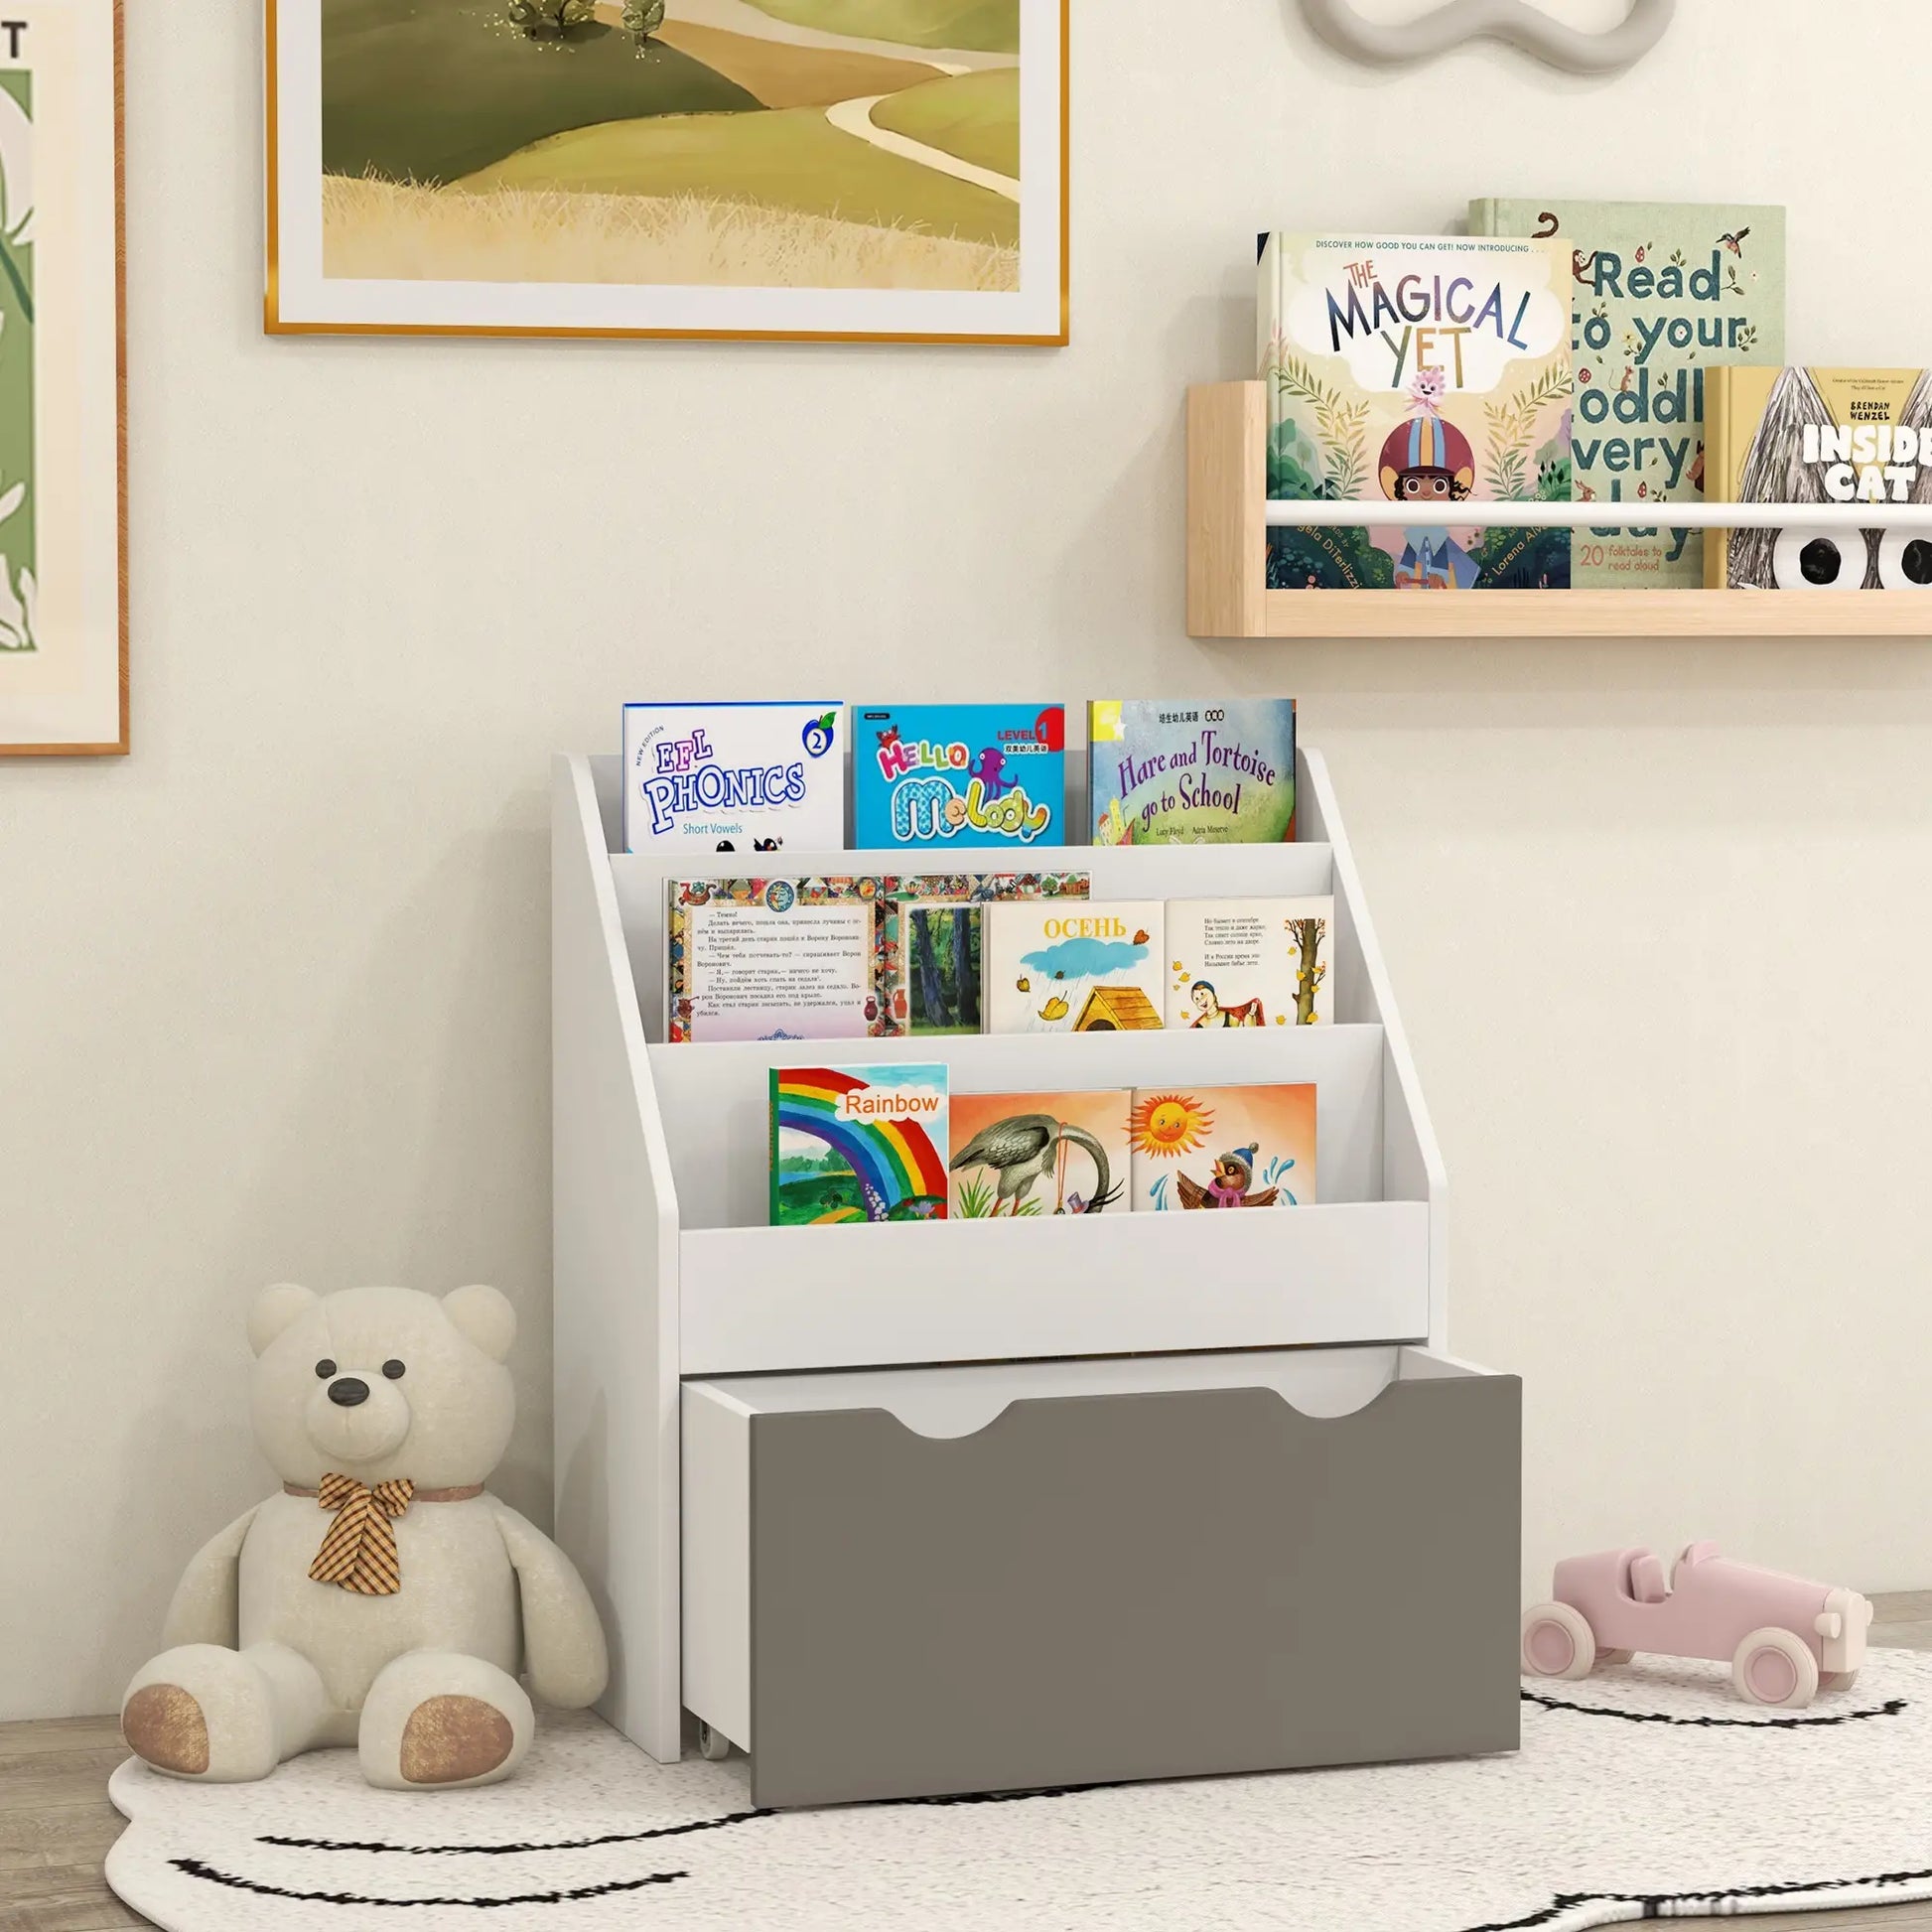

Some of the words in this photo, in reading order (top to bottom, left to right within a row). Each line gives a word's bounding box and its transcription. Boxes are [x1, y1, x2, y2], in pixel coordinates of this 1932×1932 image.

[1, 21, 28, 59] T
[1343, 260, 1378, 289] THE
[1593, 249, 1721, 302] Read
[1325, 274, 1531, 352] MAGICAL
[1380, 325, 1472, 388] YET
[1632, 316, 1746, 364] your
[1571, 367, 1704, 424] oddl
[1851, 401, 1890, 411] BRENDAN
[1850, 411, 1890, 421] WENZEL
[1571, 437, 1690, 489] very
[1802, 424, 1932, 467] INSIDE
[1824, 463, 1917, 501] CAT
[1322, 538, 1363, 589] DiTerlizzi
[1491, 541, 1526, 576] Lorena
[1581, 544, 1604, 566] 20
[1608, 544, 1648, 557] folktales
[1653, 545, 1662, 557] to
[1608, 560, 1630, 571] read
[1634, 559, 1659, 571] aloud
[635, 748, 644, 766] NEW
[641, 725, 664, 748] EDITION
[812, 732, 823, 749] 2
[997, 730, 1035, 741] LEVEL
[1037, 721, 1049, 742] 1
[656, 729, 713, 774] EFL
[879, 743, 967, 779] HELLO
[1118, 755, 1166, 800] Hare
[1170, 742, 1196, 769] and
[1201, 730, 1276, 786] Tortoise
[643, 762, 806, 835] PHONICS
[1142, 800, 1158, 833] go
[1161, 791, 1175, 812] to
[1178, 772, 1241, 814] School
[683, 824, 708, 834] Short
[711, 823, 743, 834] Vowels
[1156, 827, 1170, 837] Lucy
[1043, 917, 1127, 938] ОСЕНЬ
[846, 1093, 939, 1114] Rainbow
